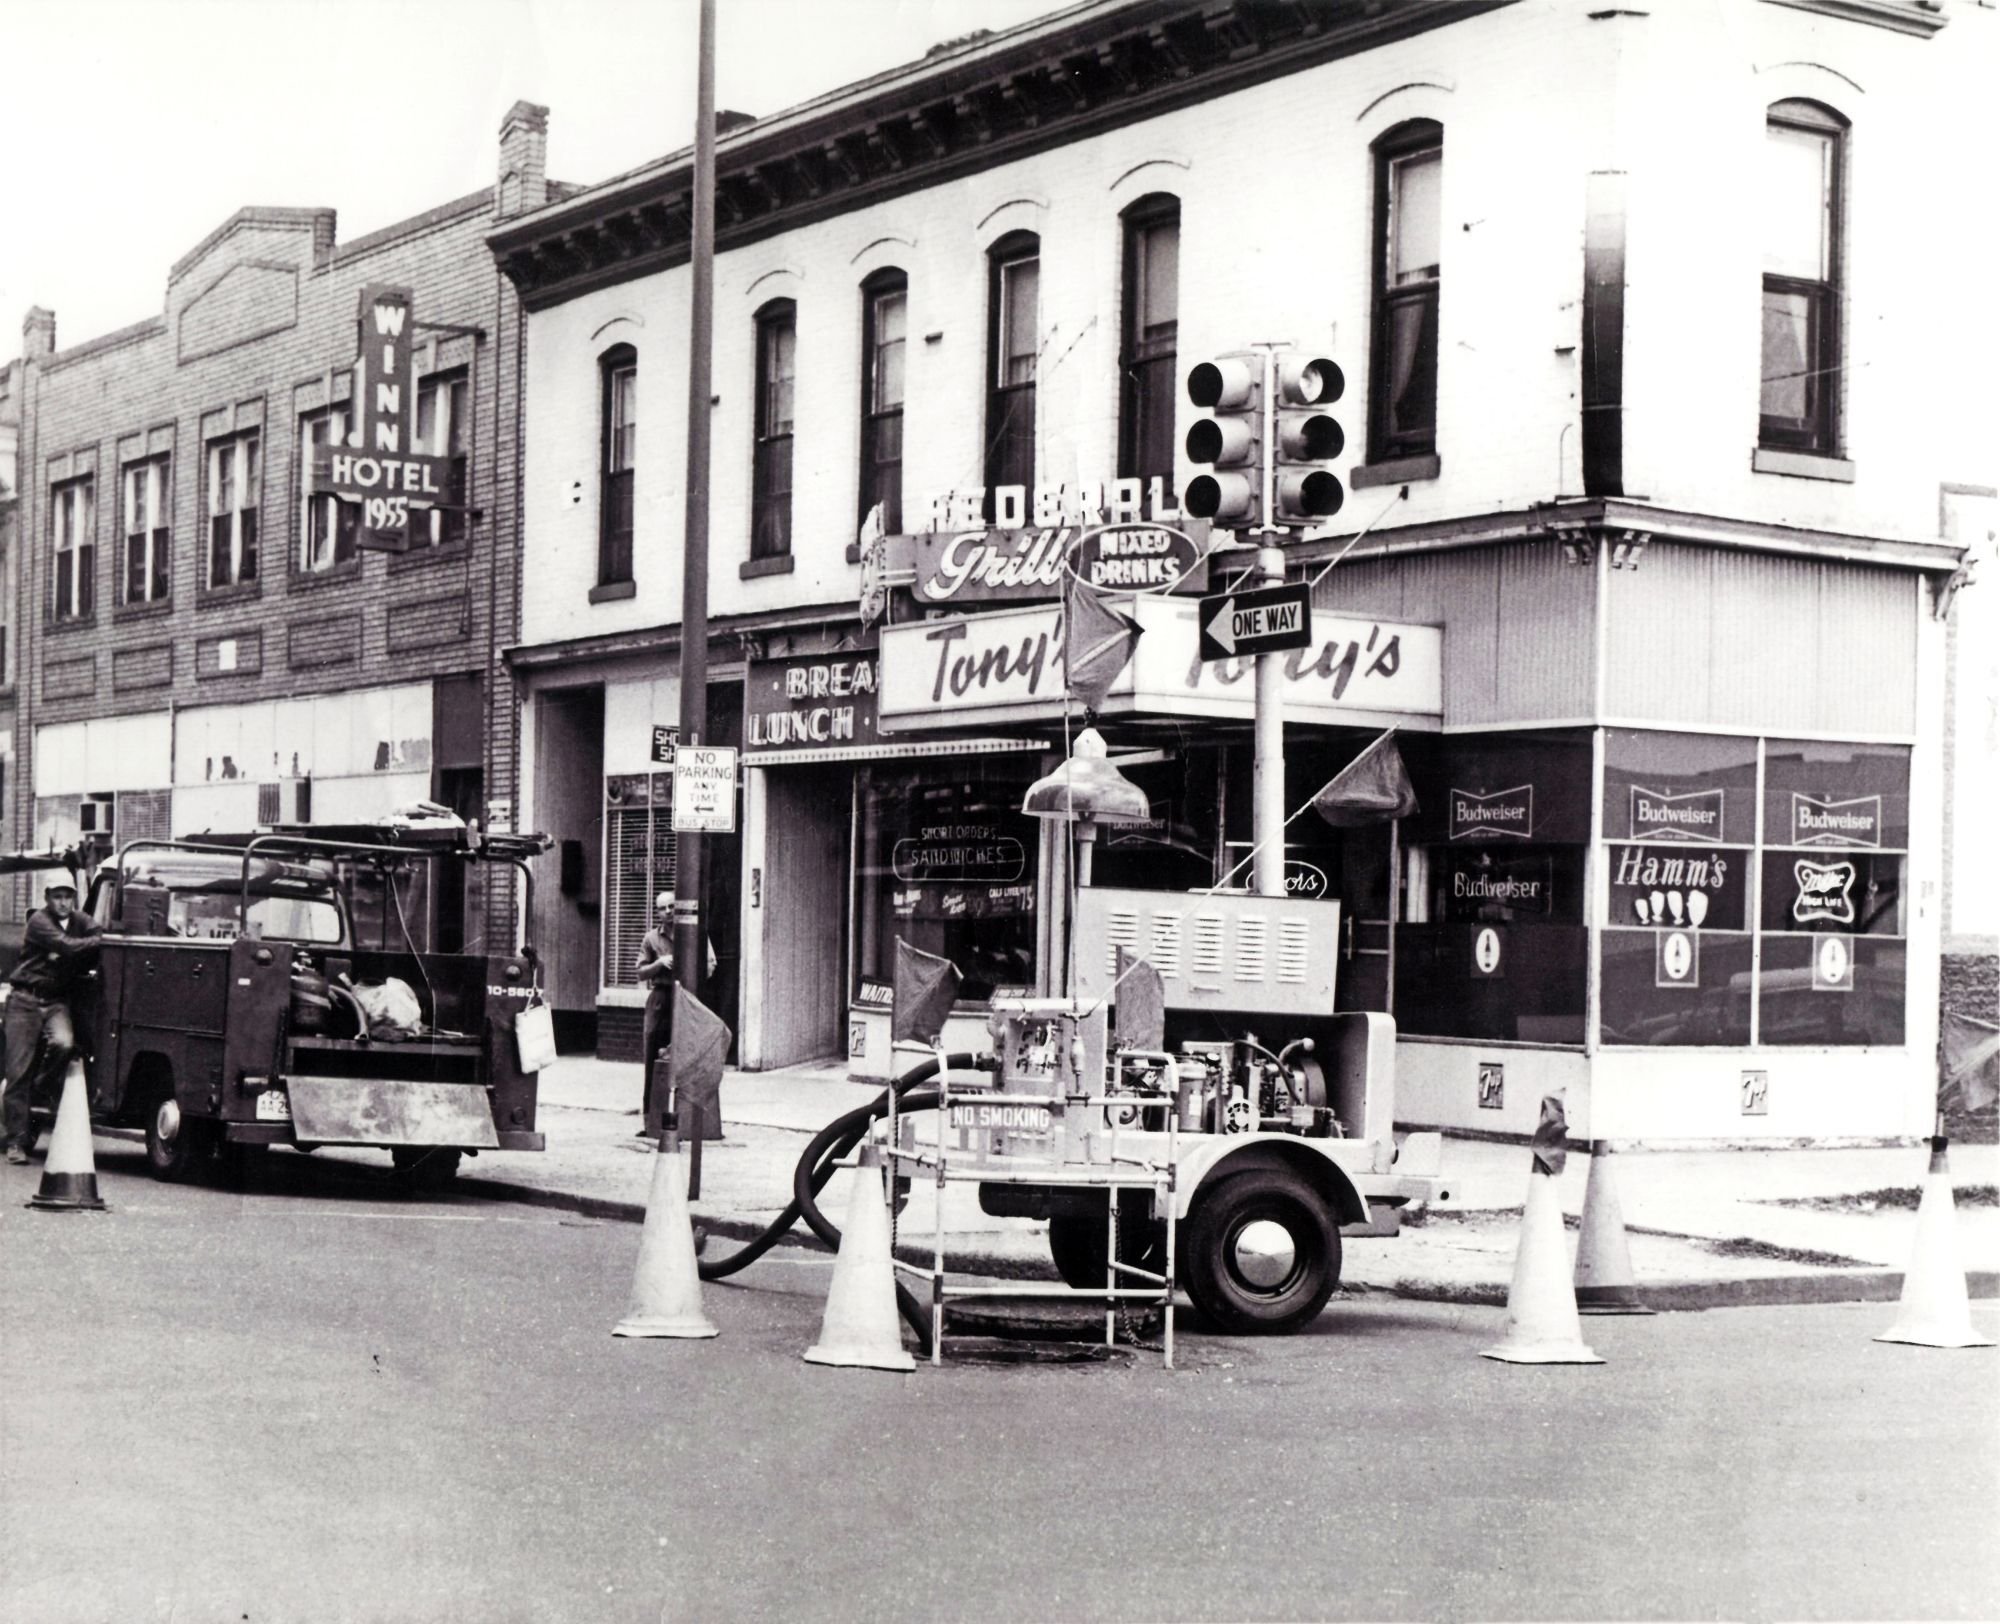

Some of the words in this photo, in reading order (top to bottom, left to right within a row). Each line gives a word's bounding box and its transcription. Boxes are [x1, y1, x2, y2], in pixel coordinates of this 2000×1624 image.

[374, 304, 406, 452] WINN
[332, 454, 440, 494] HOTEL
[364, 496, 409, 530] 1955
[1100, 529, 1171, 558] MIXED
[923, 529, 1071, 600] Grill
[1091, 557, 1181, 586] DRINKS
[1232, 610, 1262, 638] ONE
[1266, 604, 1298, 634] WAY
[786, 660, 880, 699] BREA
[748, 705, 854, 745] LUNCH
[695, 752, 716, 764] NO
[678, 766, 732, 780] PARKING
[693, 782, 716, 790] ANY
[689, 794, 719, 803] TIME
[1456, 801, 1525, 821] Budweiser
[1638, 799, 1716, 824] Budweiser
[678, 818, 697, 827] BUS
[704, 817, 729, 828] STOP
[1799, 806, 1874, 829] Budweiser
[1614, 847, 1727, 888] Hamm's
[1454, 871, 1540, 897] Budweiser
[954, 1106, 974, 1126] NO
[979, 1107, 1050, 1128] SMOKING
